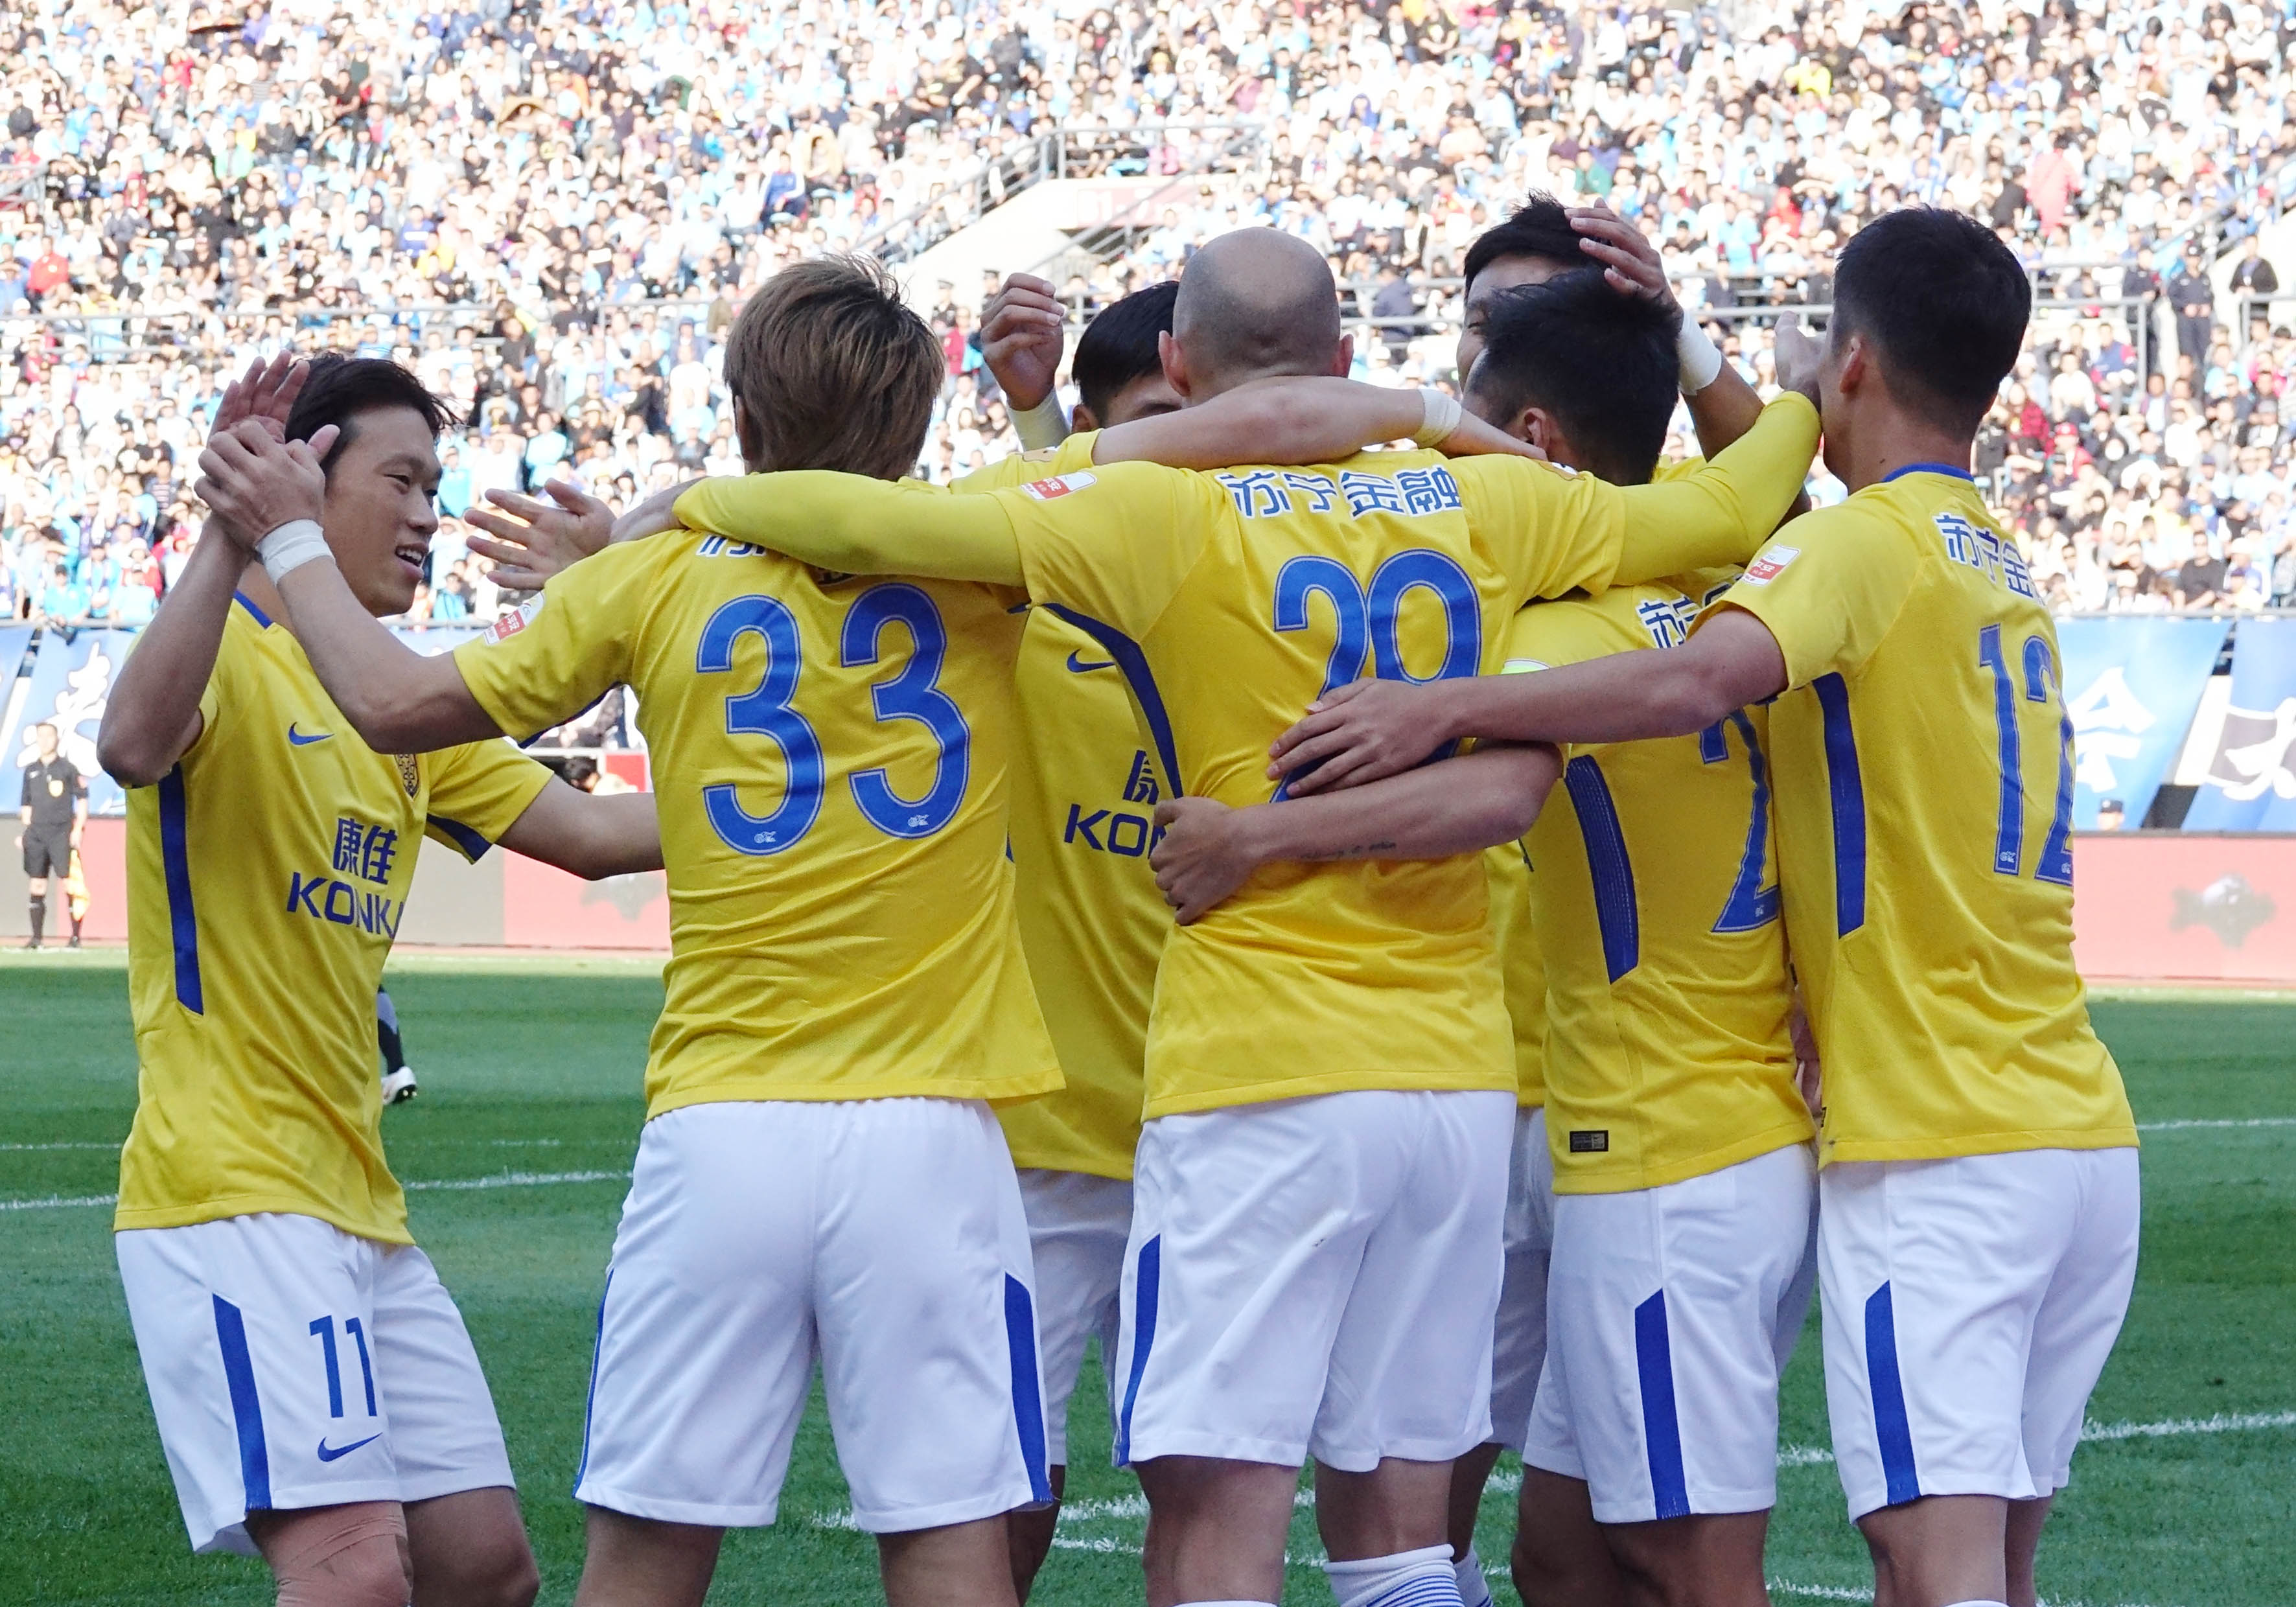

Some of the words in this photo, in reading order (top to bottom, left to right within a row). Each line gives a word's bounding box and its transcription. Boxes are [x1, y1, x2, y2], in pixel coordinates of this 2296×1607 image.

[1216, 465, 1463, 519] 苏宁金融
[1934, 514, 2047, 607] 苏宁金
[696, 583, 971, 857] 33
[1979, 623, 2074, 886] 12
[332, 818, 398, 885] 康佳
[309, 1315, 377, 1418] 11
